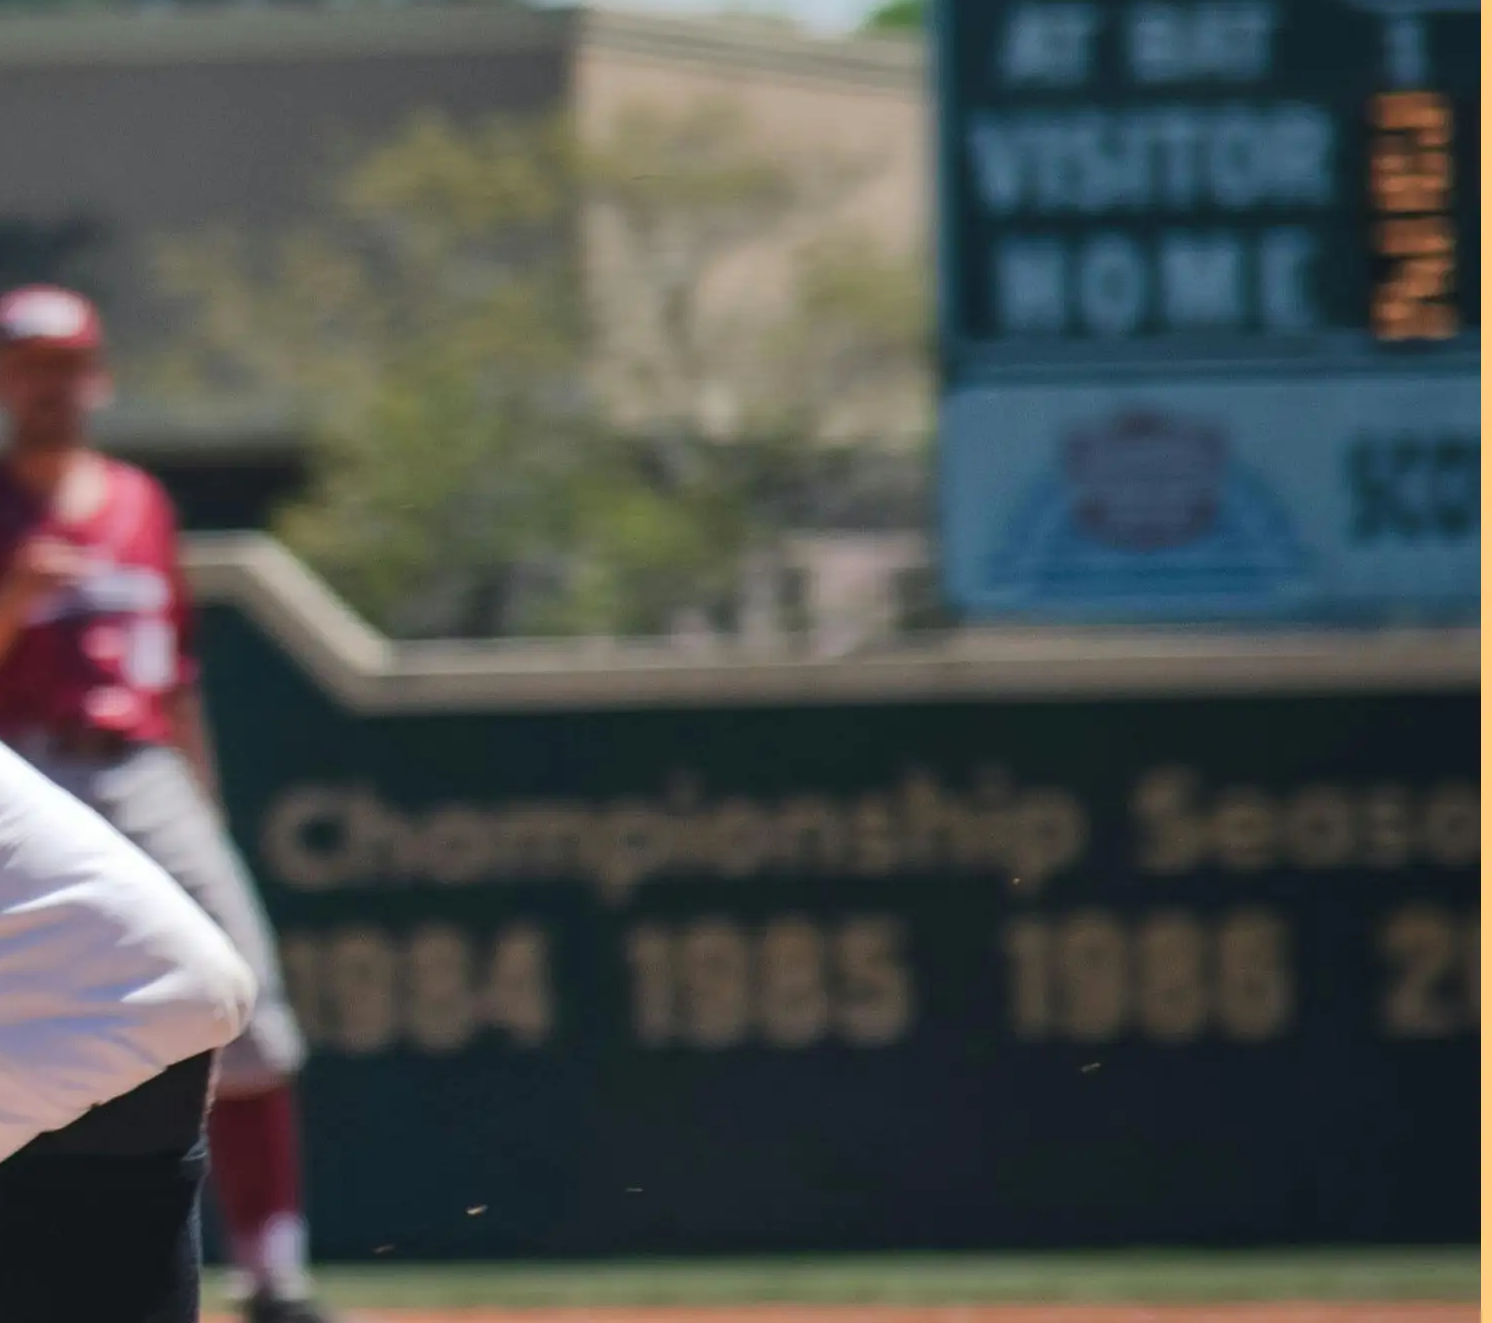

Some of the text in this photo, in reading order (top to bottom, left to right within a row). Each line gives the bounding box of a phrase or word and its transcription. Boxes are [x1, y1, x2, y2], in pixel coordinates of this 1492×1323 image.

[1003, 0, 1098, 84] AT
[970, 104, 1331, 213] VISITOR
[996, 228, 1316, 335] HOME
[260, 768, 1088, 902] Championship
[282, 918, 556, 1052] 1984
[624, 914, 913, 1047] 1985
[1004, 906, 1295, 1044] 1986
